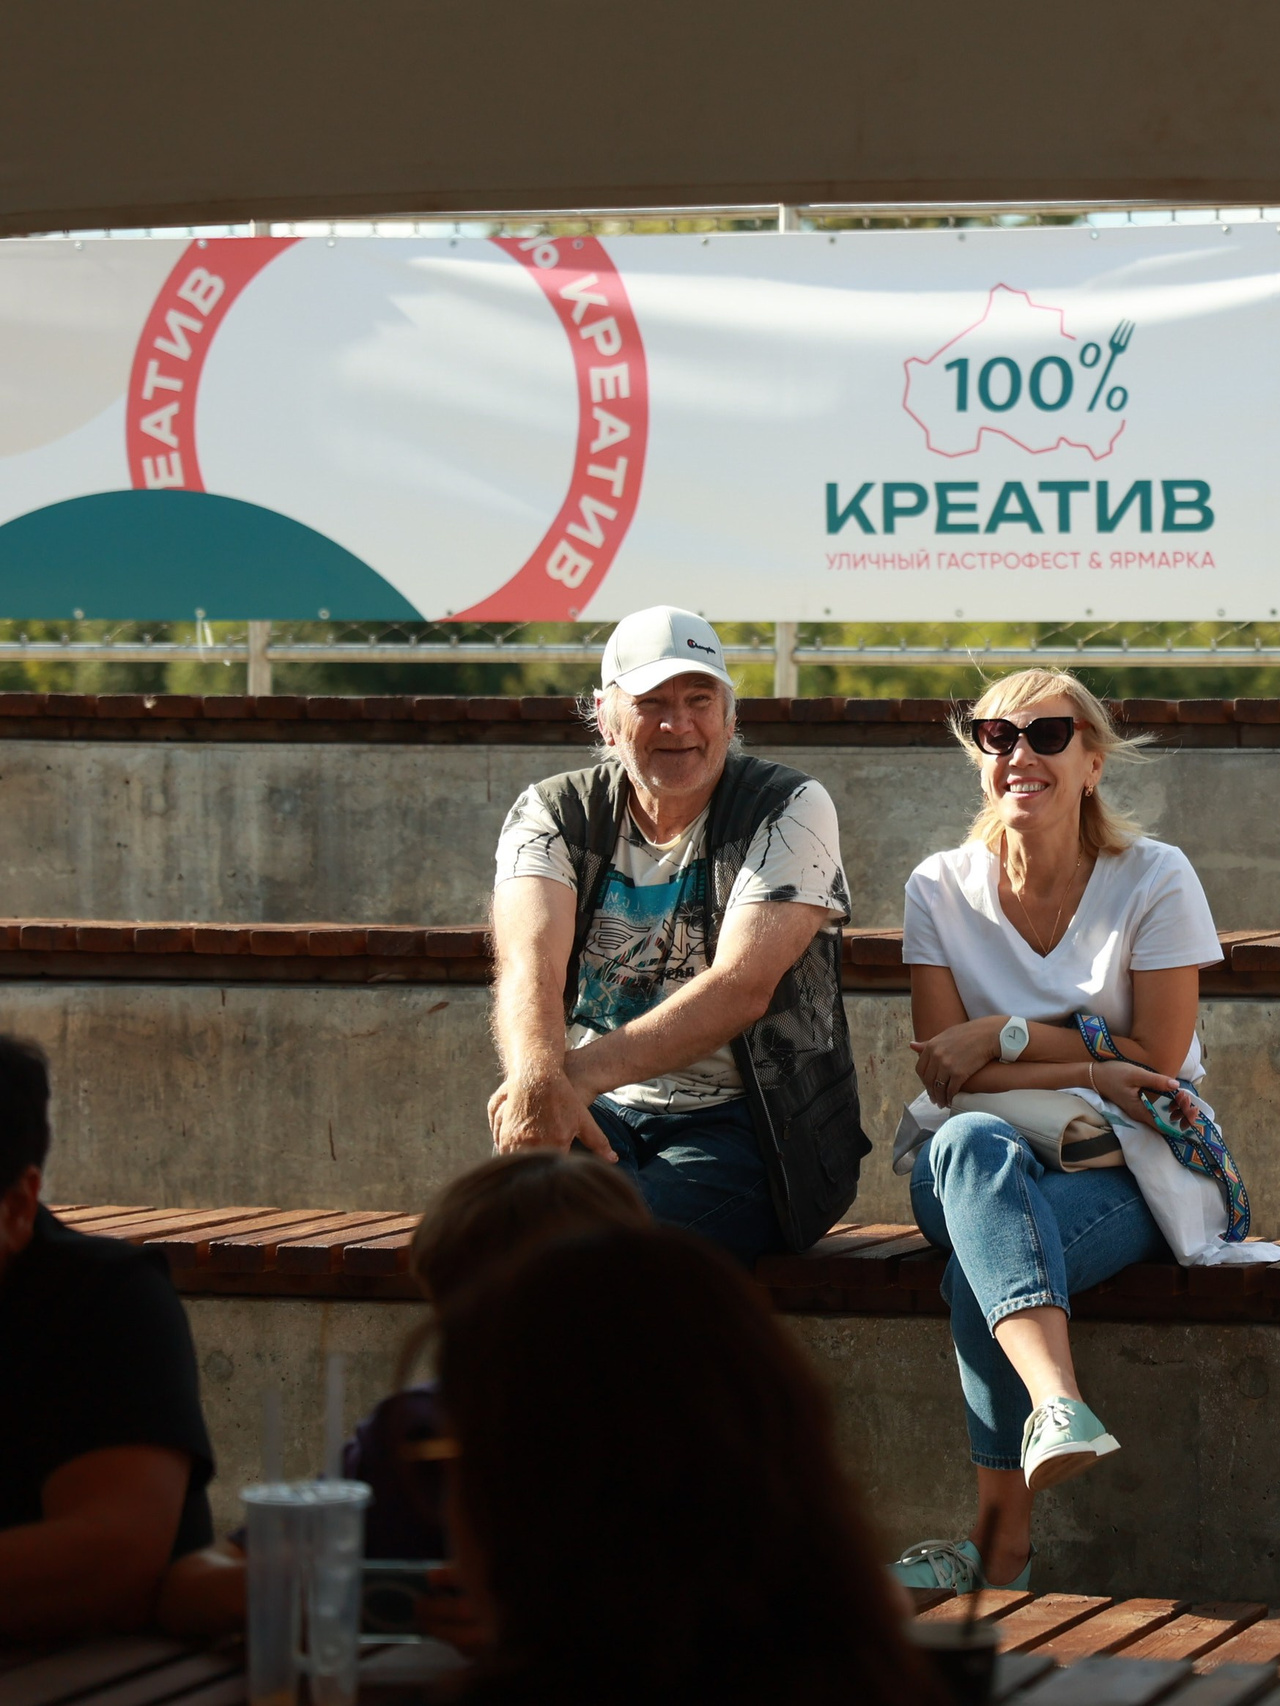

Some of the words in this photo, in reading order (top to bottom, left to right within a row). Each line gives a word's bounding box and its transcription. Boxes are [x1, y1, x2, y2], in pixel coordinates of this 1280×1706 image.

[944, 317, 1135, 413] 100%
[546, 272, 631, 590] КРЕАТИВ
[826, 479, 1215, 535] КРЕАТИВ
[826, 549, 931, 571] УЛИЧНЫЙ
[937, 551, 1080, 570] ГАСТРОФЕСТ
[1088, 550, 1103, 569] &
[1110, 551, 1216, 569] ЯРМАРКА
